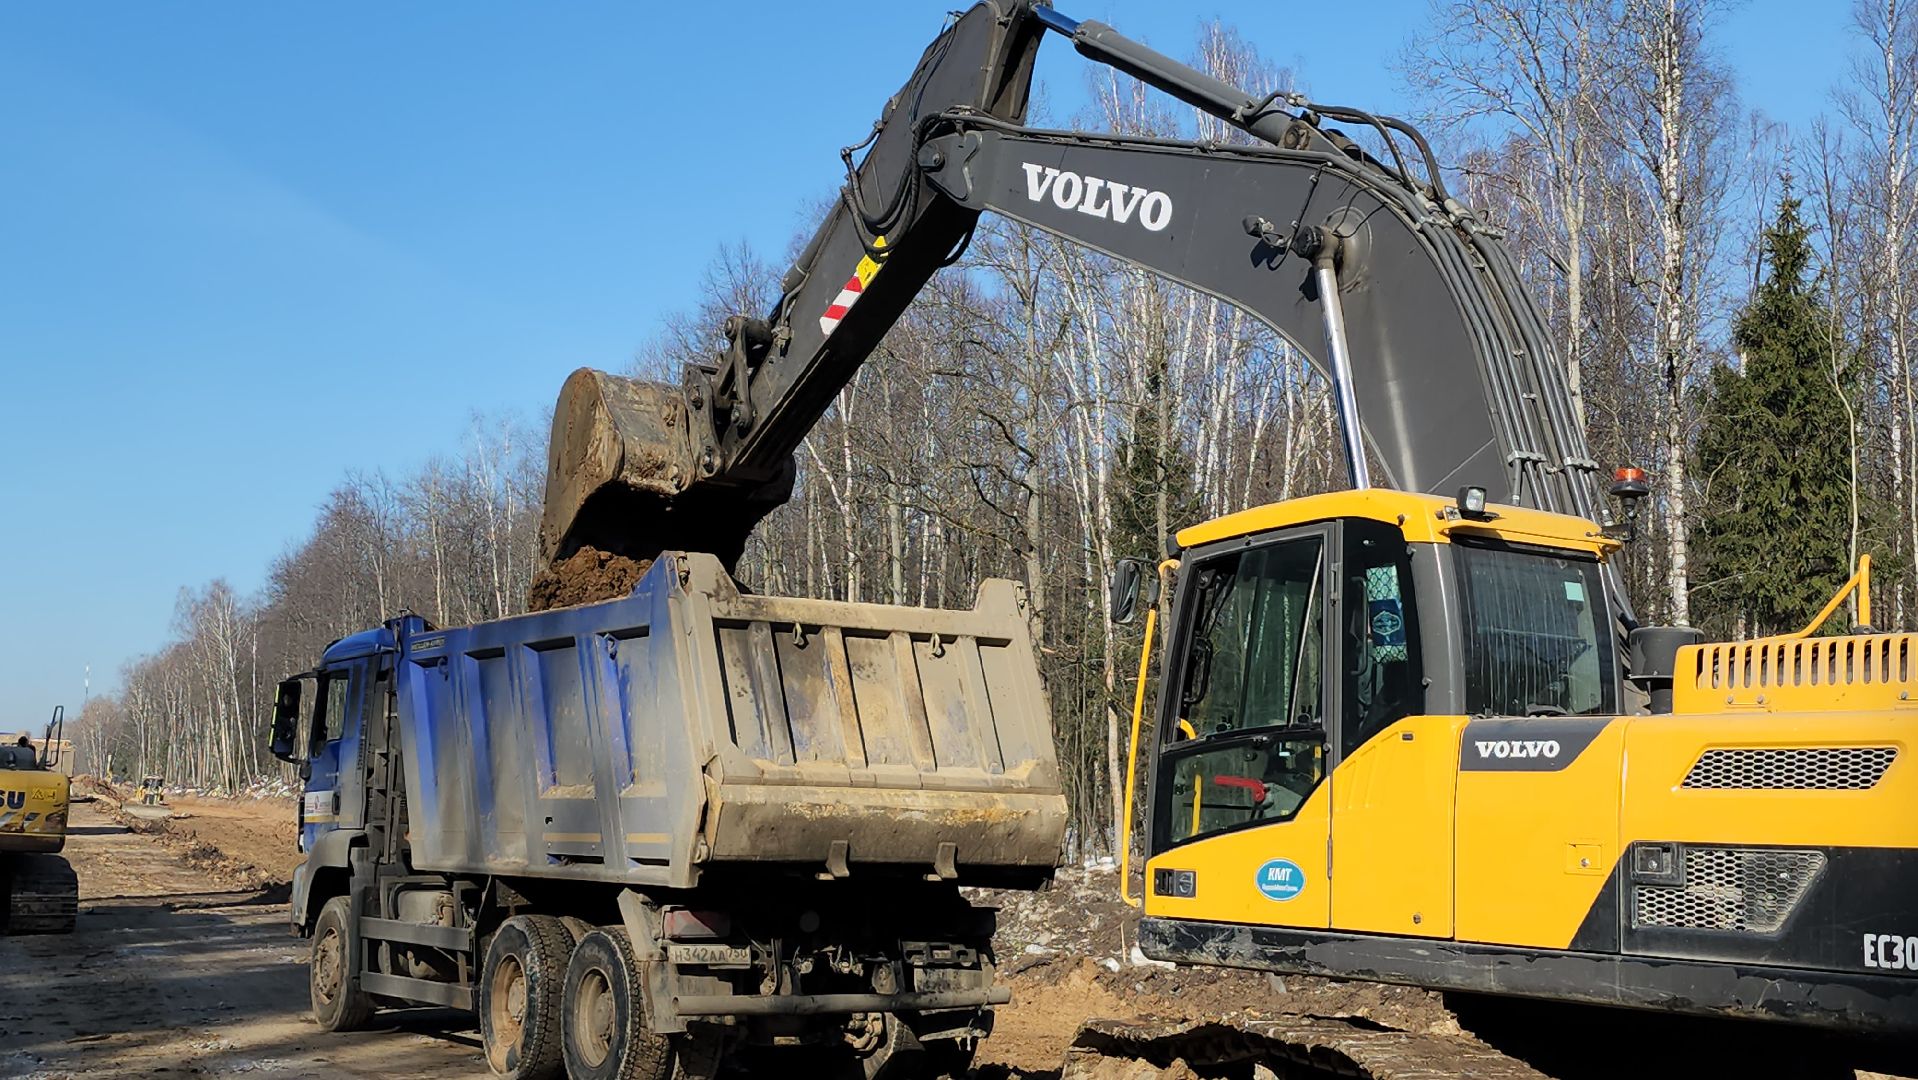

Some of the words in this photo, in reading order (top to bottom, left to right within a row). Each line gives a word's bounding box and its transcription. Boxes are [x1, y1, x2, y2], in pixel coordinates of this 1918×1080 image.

[1022, 162, 1173, 231] VOLVO
[1475, 740, 1561, 758] VOLVO
[1863, 933, 1918, 970] EC30
